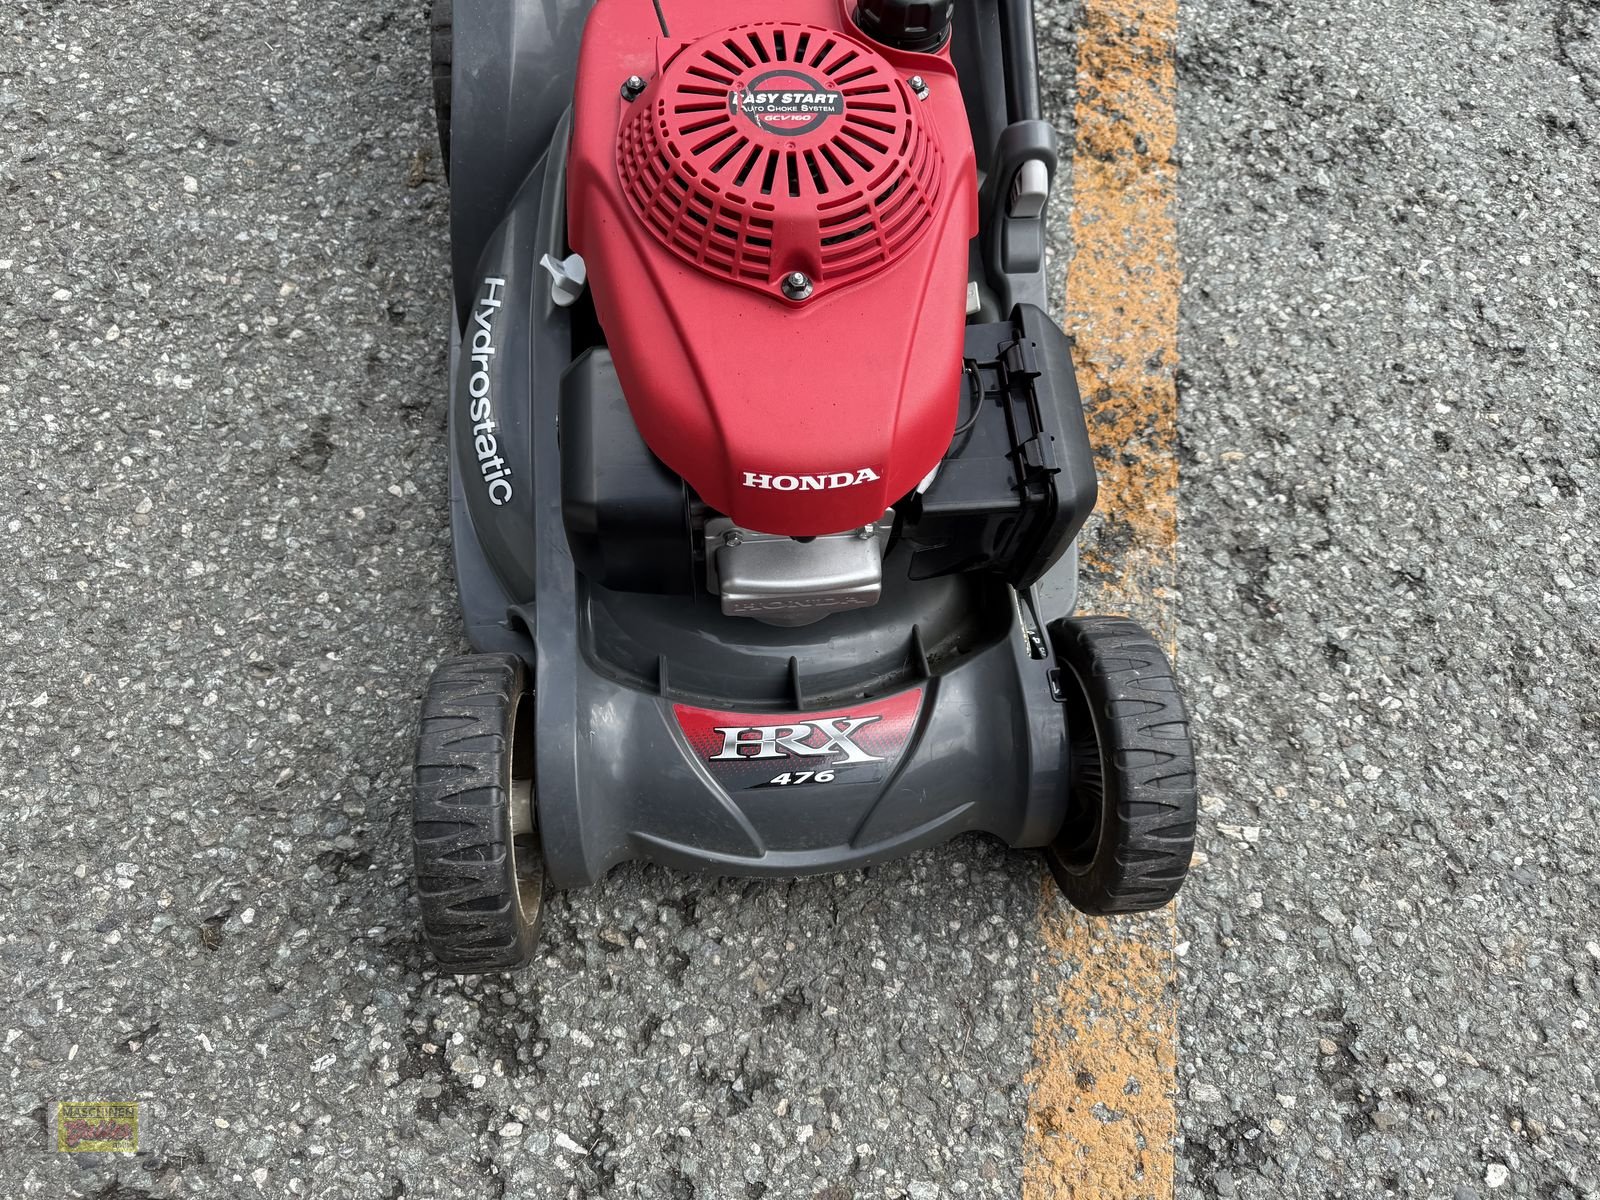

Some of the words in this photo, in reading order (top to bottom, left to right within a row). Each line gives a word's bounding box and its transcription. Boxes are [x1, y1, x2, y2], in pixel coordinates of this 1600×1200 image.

[781, 93, 838, 104] START
[469, 277, 513, 506] Hydrostatic
[743, 467, 880, 491] HONDA
[734, 596, 867, 612] HONDA
[708, 715, 886, 766] HRX
[770, 769, 835, 786] 476
